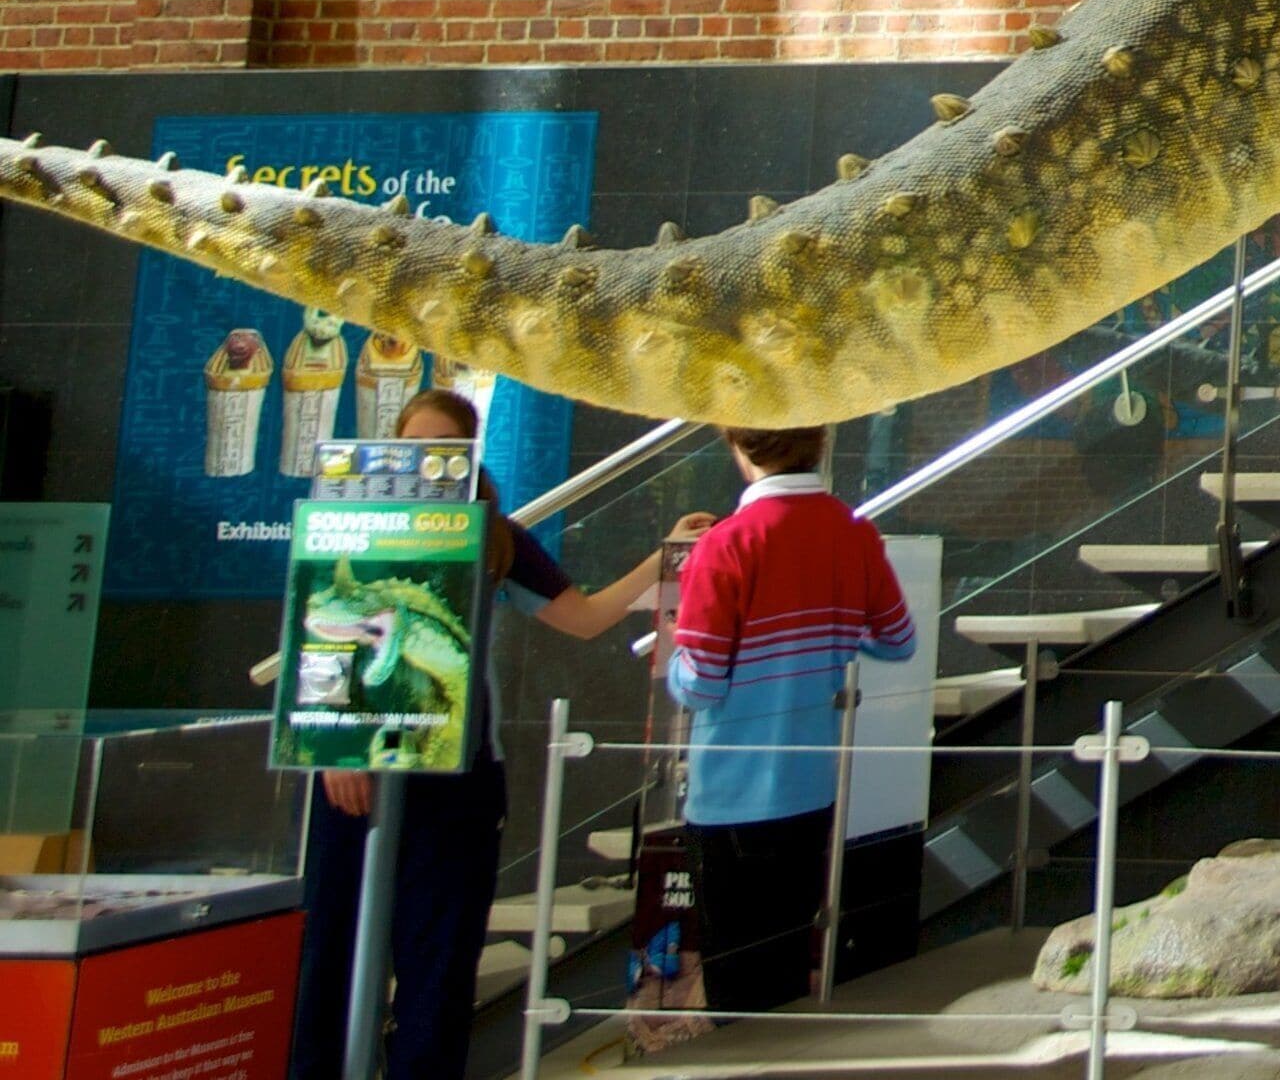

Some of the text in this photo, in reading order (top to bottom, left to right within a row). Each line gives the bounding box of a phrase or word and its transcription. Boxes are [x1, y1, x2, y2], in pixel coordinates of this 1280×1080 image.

[382, 169, 410, 196] of
[415, 169, 456, 195] the
[217, 521, 292, 541] Exhibiti
[306, 512, 469, 532] SOUVENIR GOLD
[305, 533, 370, 553] COINS
[290, 711, 449, 726] WESTERN AUSTRALIAN MUSEUM
[147, 971, 241, 1006] Welcome to the
[100, 989, 275, 1045] Western Australian Museum
